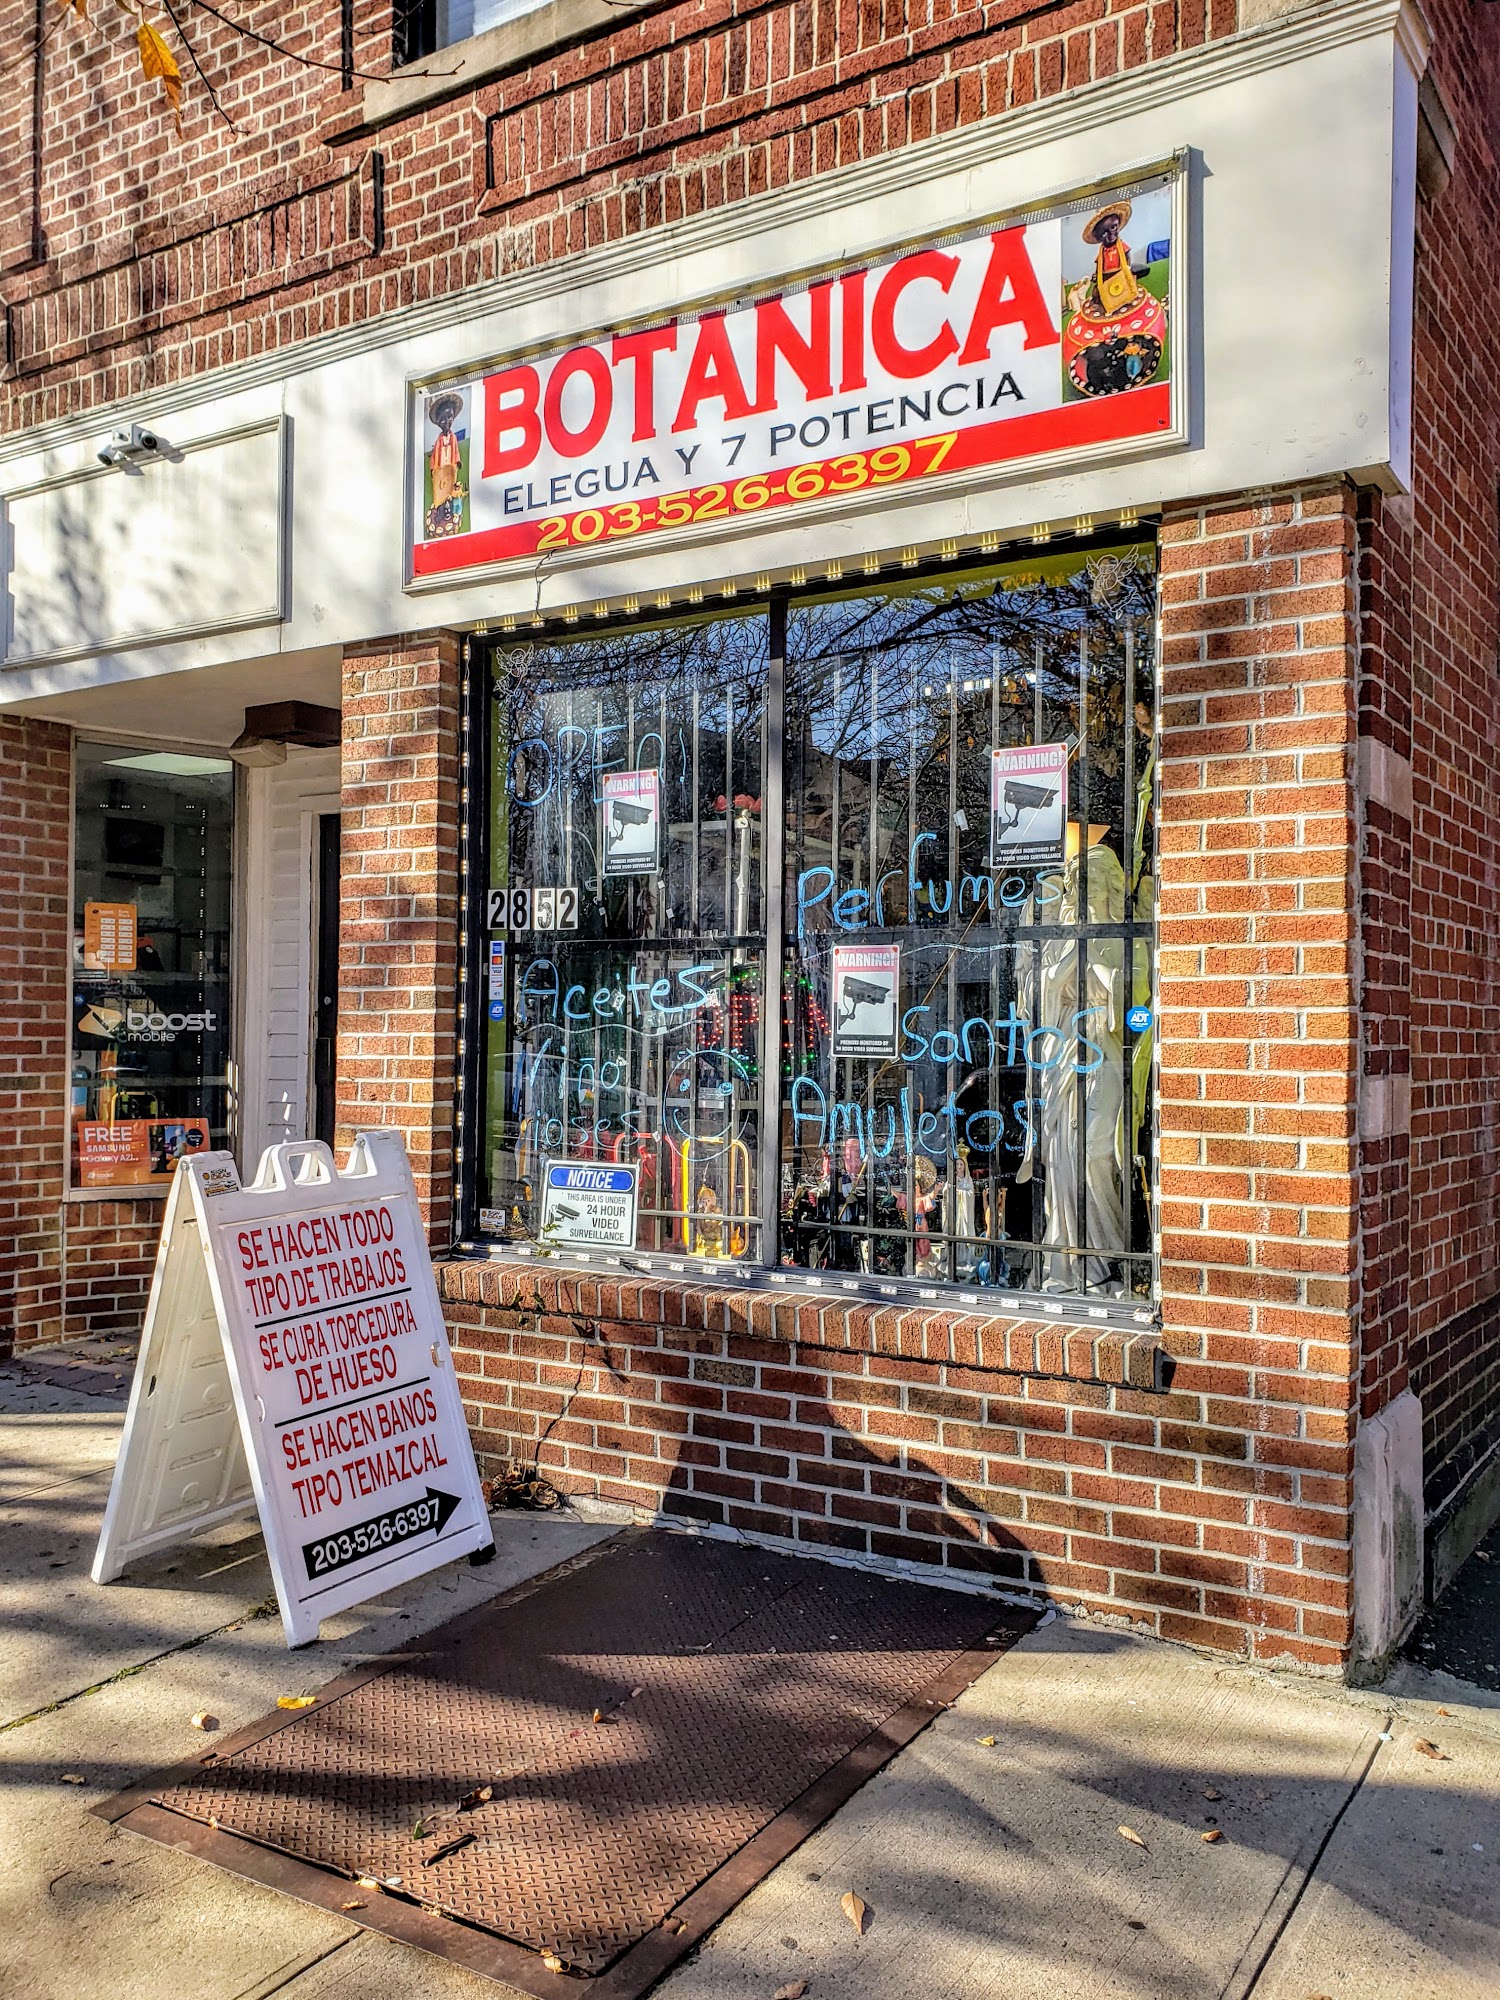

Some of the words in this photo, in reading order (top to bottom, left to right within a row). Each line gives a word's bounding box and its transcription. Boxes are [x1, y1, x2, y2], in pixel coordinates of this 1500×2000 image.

[481, 224, 1061, 479] BOTANICA
[504, 457, 660, 515] ELEGUA
[674, 447, 704, 477] Y
[721, 434, 747, 463] 7
[769, 371, 1028, 456] POTENCIA
[536, 431, 959, 552] 203-526-6397
[998, 751, 1063, 772] WARNING!
[607, 776, 655, 793] WARNING!
[797, 832, 1064, 939] Perfumes
[489, 890, 576, 930] 2852
[838, 952, 895, 967] WARNING!
[126, 1008, 216, 1031] boost
[491, 1006, 504, 1014] ADT
[698, 994, 832, 1047] OPN
[1130, 1013, 1150, 1023] ADT
[127, 1031, 176, 1042] mobile
[901, 1001, 1104, 1074] Santos
[791, 1076, 1048, 1159] Amuletos
[84, 1126, 133, 1143] FREE
[86, 1143, 131, 1153] SAMSUNG
[88, 1154, 119, 1164] Galaxy
[566, 1169, 614, 1189] NOTICE
[567, 1193, 580, 1202] THIS
[580, 1194, 596, 1203] AREA
[597, 1195, 604, 1203] IS
[605, 1196, 627, 1205] UNDER
[587, 1204, 598, 1215] 24
[600, 1205, 626, 1217] HOUR
[238, 1226, 270, 1271] SE
[267, 1215, 343, 1264] HACEN
[339, 1206, 394, 1250] TODO
[569, 1228, 625, 1241] SURVEILLANCE
[592, 1217, 619, 1230] VIDEO
[245, 1273, 291, 1319] TIPO
[291, 1266, 320, 1307] DE
[318, 1248, 407, 1299] TRABAJOS
[259, 1335, 284, 1372] SE
[283, 1321, 328, 1366] CURA
[325, 1299, 417, 1354] TORCEDURA
[295, 1364, 330, 1406] DE
[331, 1344, 398, 1398] HUESO
[281, 1431, 311, 1471] SE
[310, 1407, 378, 1464] HACEN
[377, 1387, 438, 1440] BANOS
[291, 1472, 343, 1519] TIPO
[342, 1432, 448, 1501] TEMAZCAL
[312, 1498, 441, 1573] 203-526-6397
